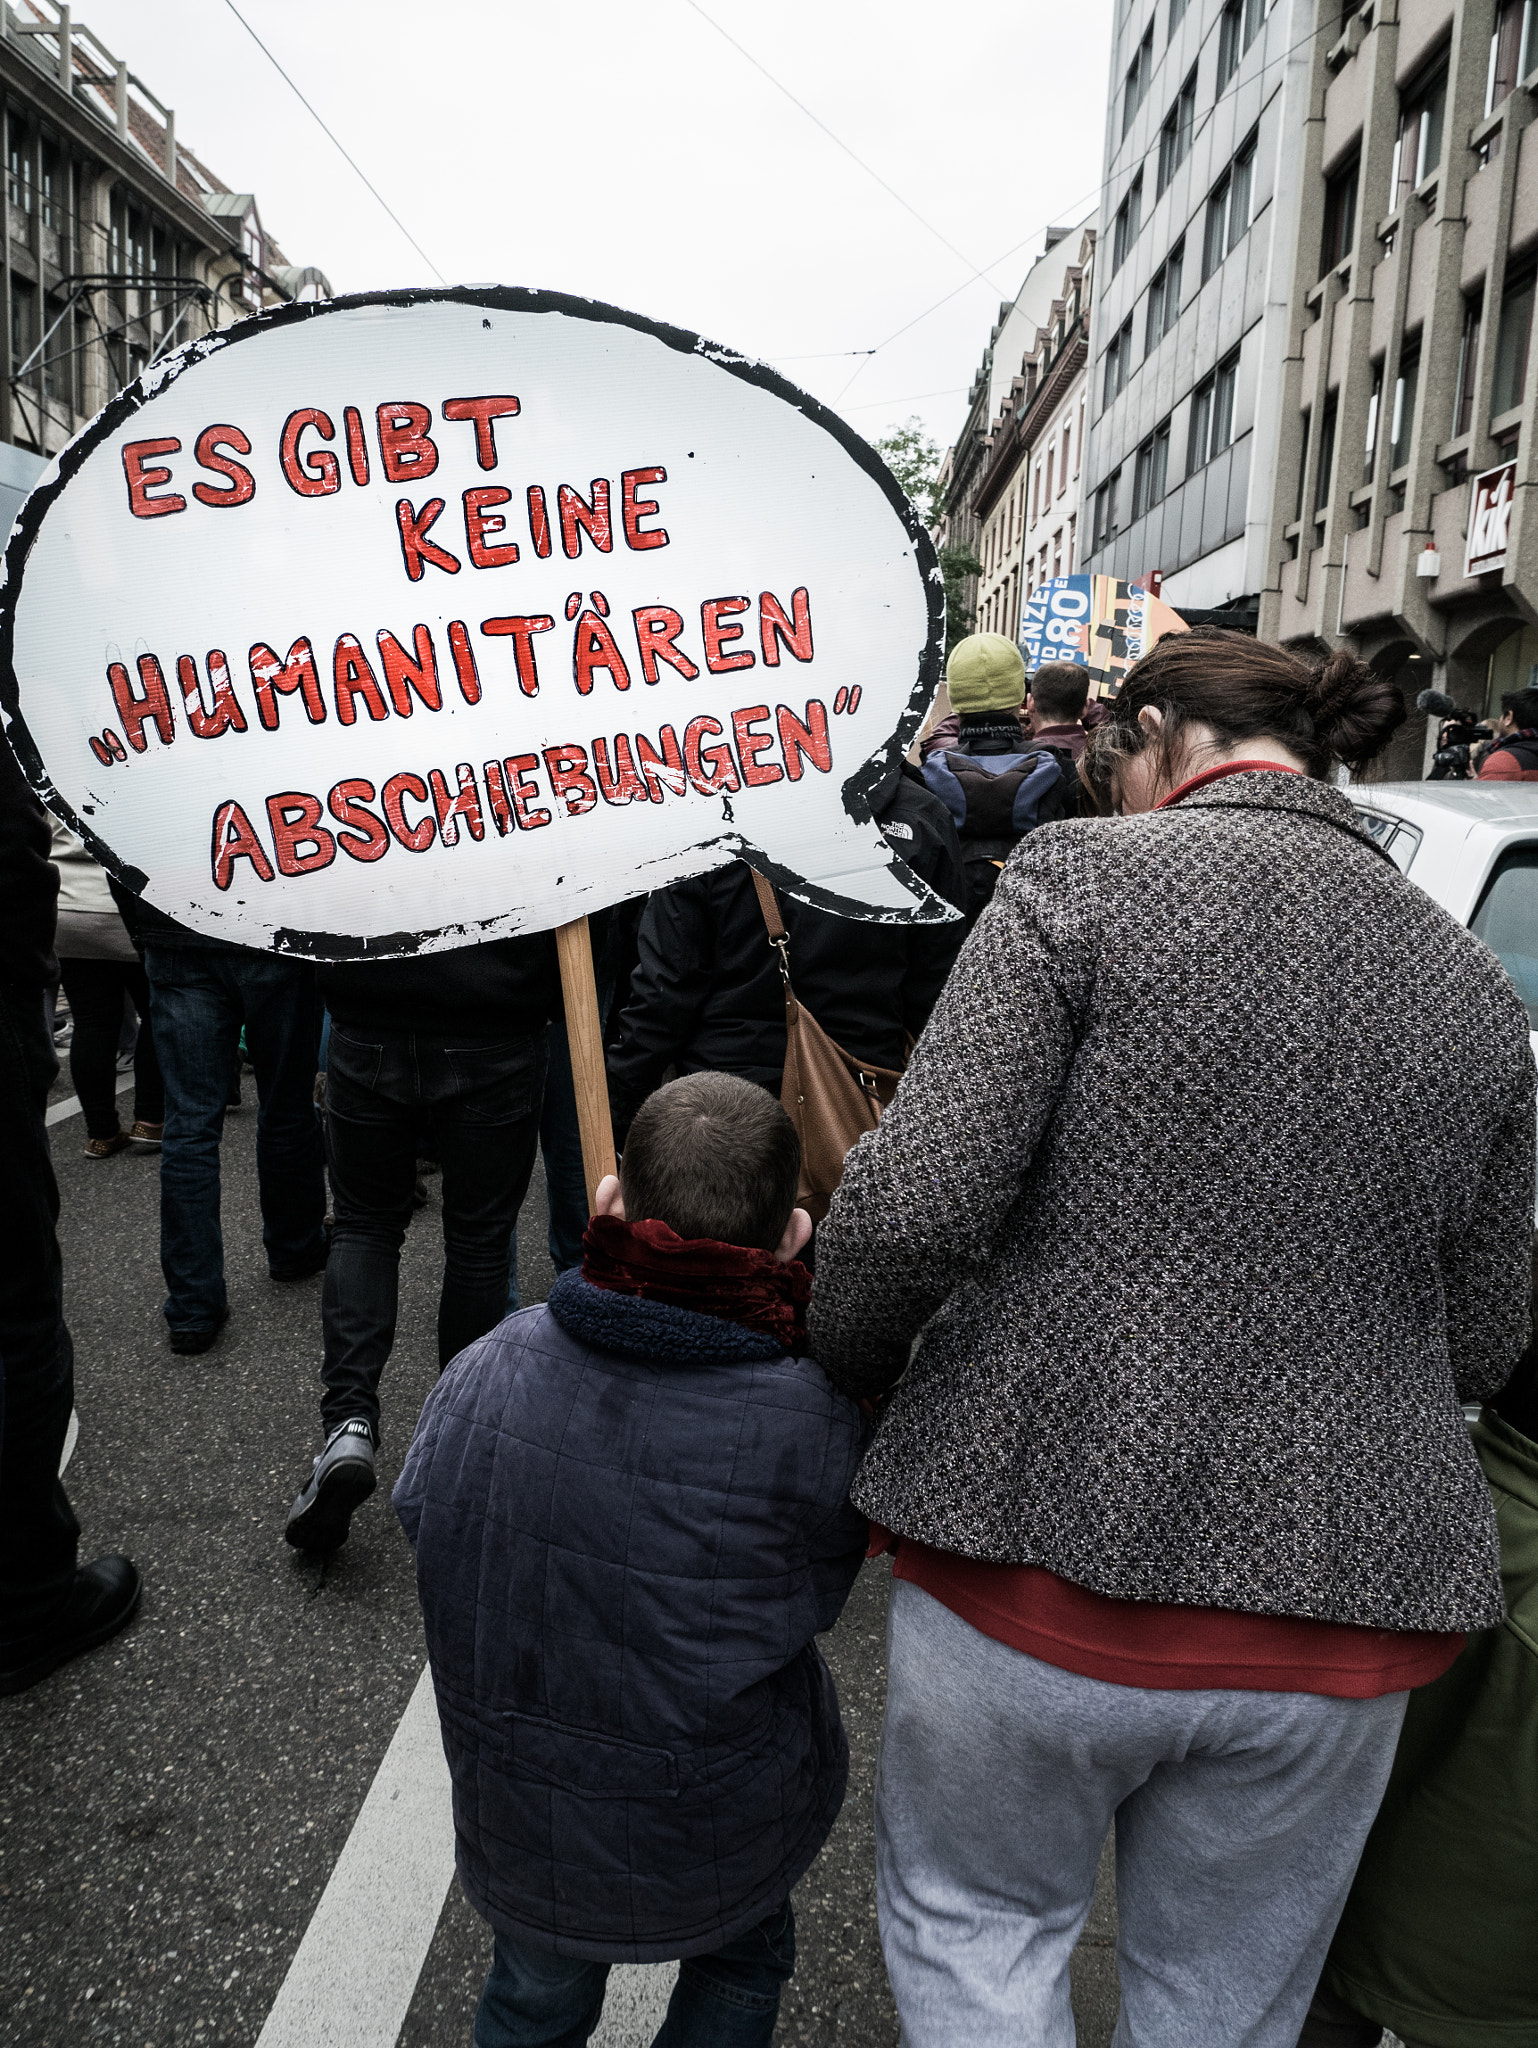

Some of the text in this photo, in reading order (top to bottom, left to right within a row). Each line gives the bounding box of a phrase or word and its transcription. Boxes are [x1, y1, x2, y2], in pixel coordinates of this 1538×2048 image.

[122, 395, 521, 518] ES GIBT
[395, 466, 669, 580] KEINE
